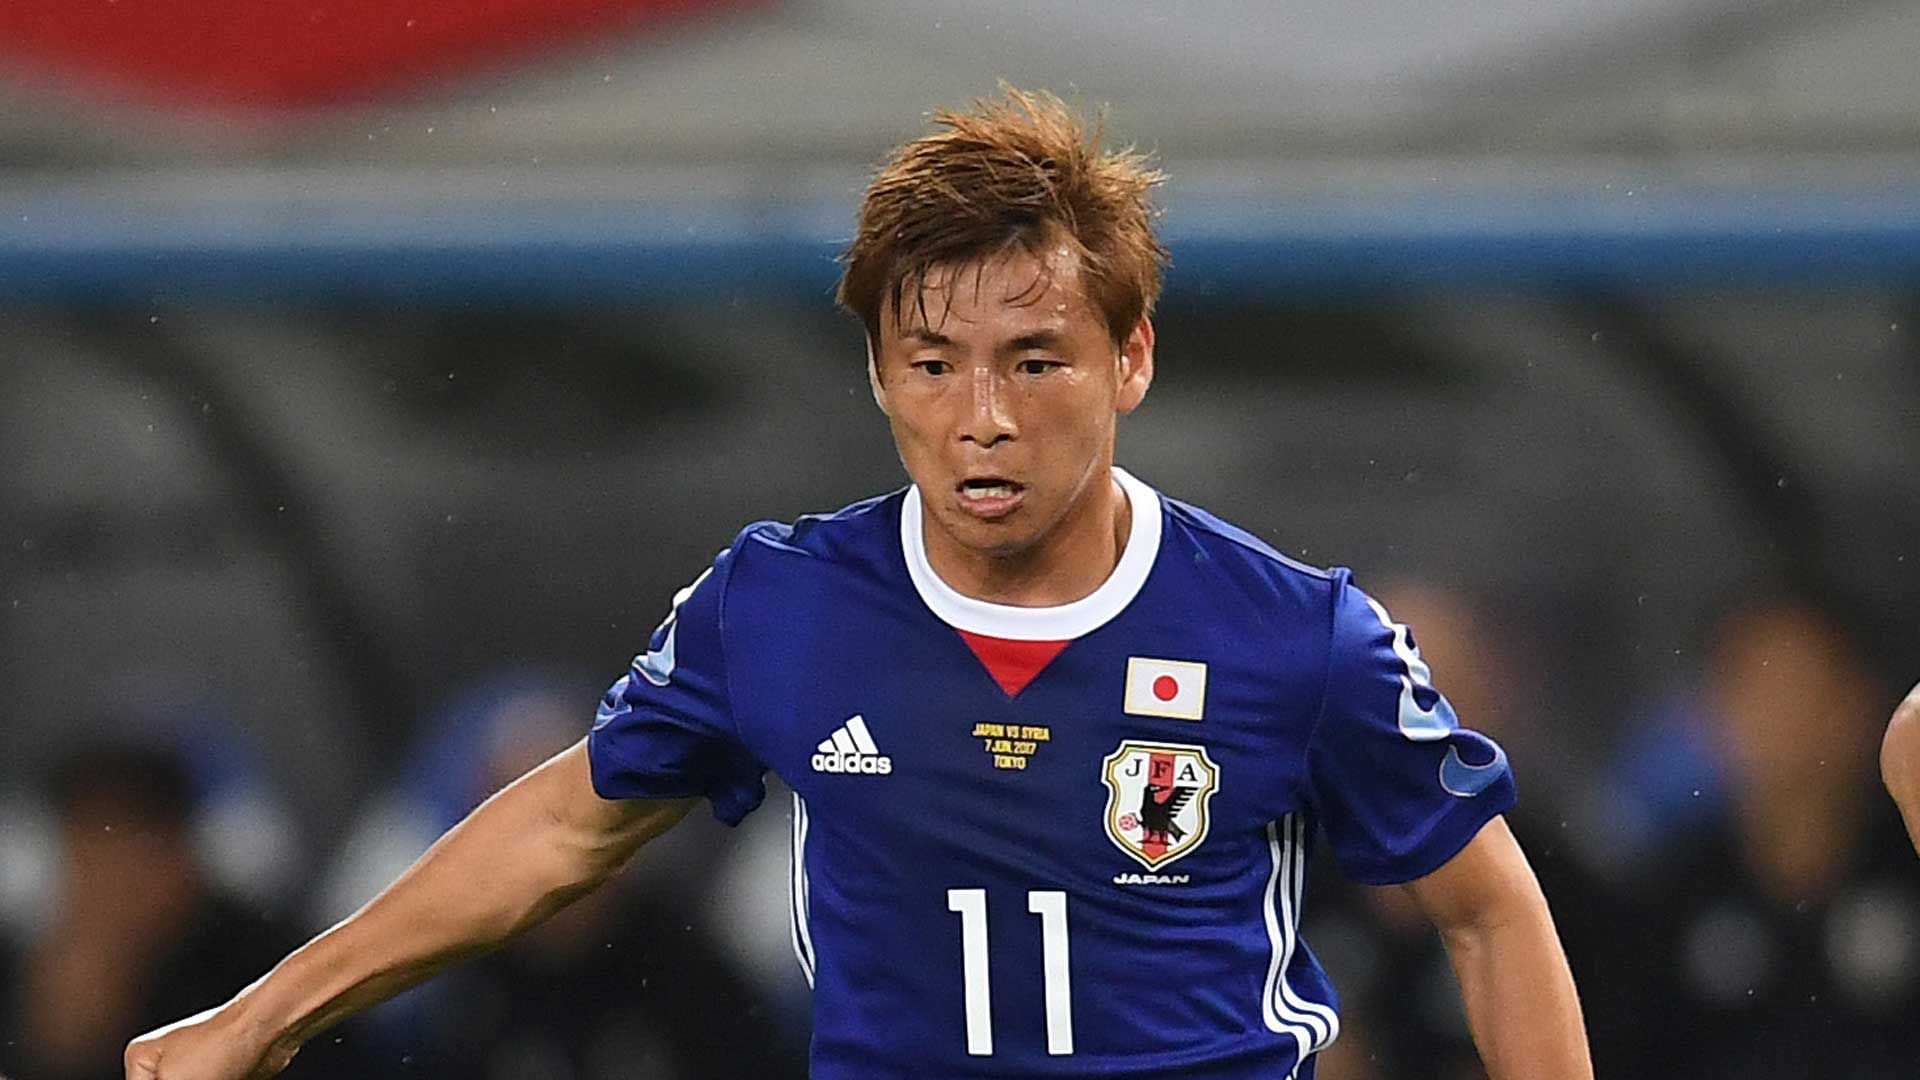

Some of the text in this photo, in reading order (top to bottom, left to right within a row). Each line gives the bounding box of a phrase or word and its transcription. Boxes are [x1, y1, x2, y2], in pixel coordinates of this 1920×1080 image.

[972, 723, 1050, 741] JAPAN VS SYRIA
[985, 739, 992, 752] 7
[1013, 741, 1036, 755] 2017
[811, 751, 892, 774] adidas
[994, 755, 1026, 770] TOKYO
[1124, 758, 1198, 782] JFA
[1113, 873, 1190, 885] JAPAN
[947, 889, 1074, 1055] 11
